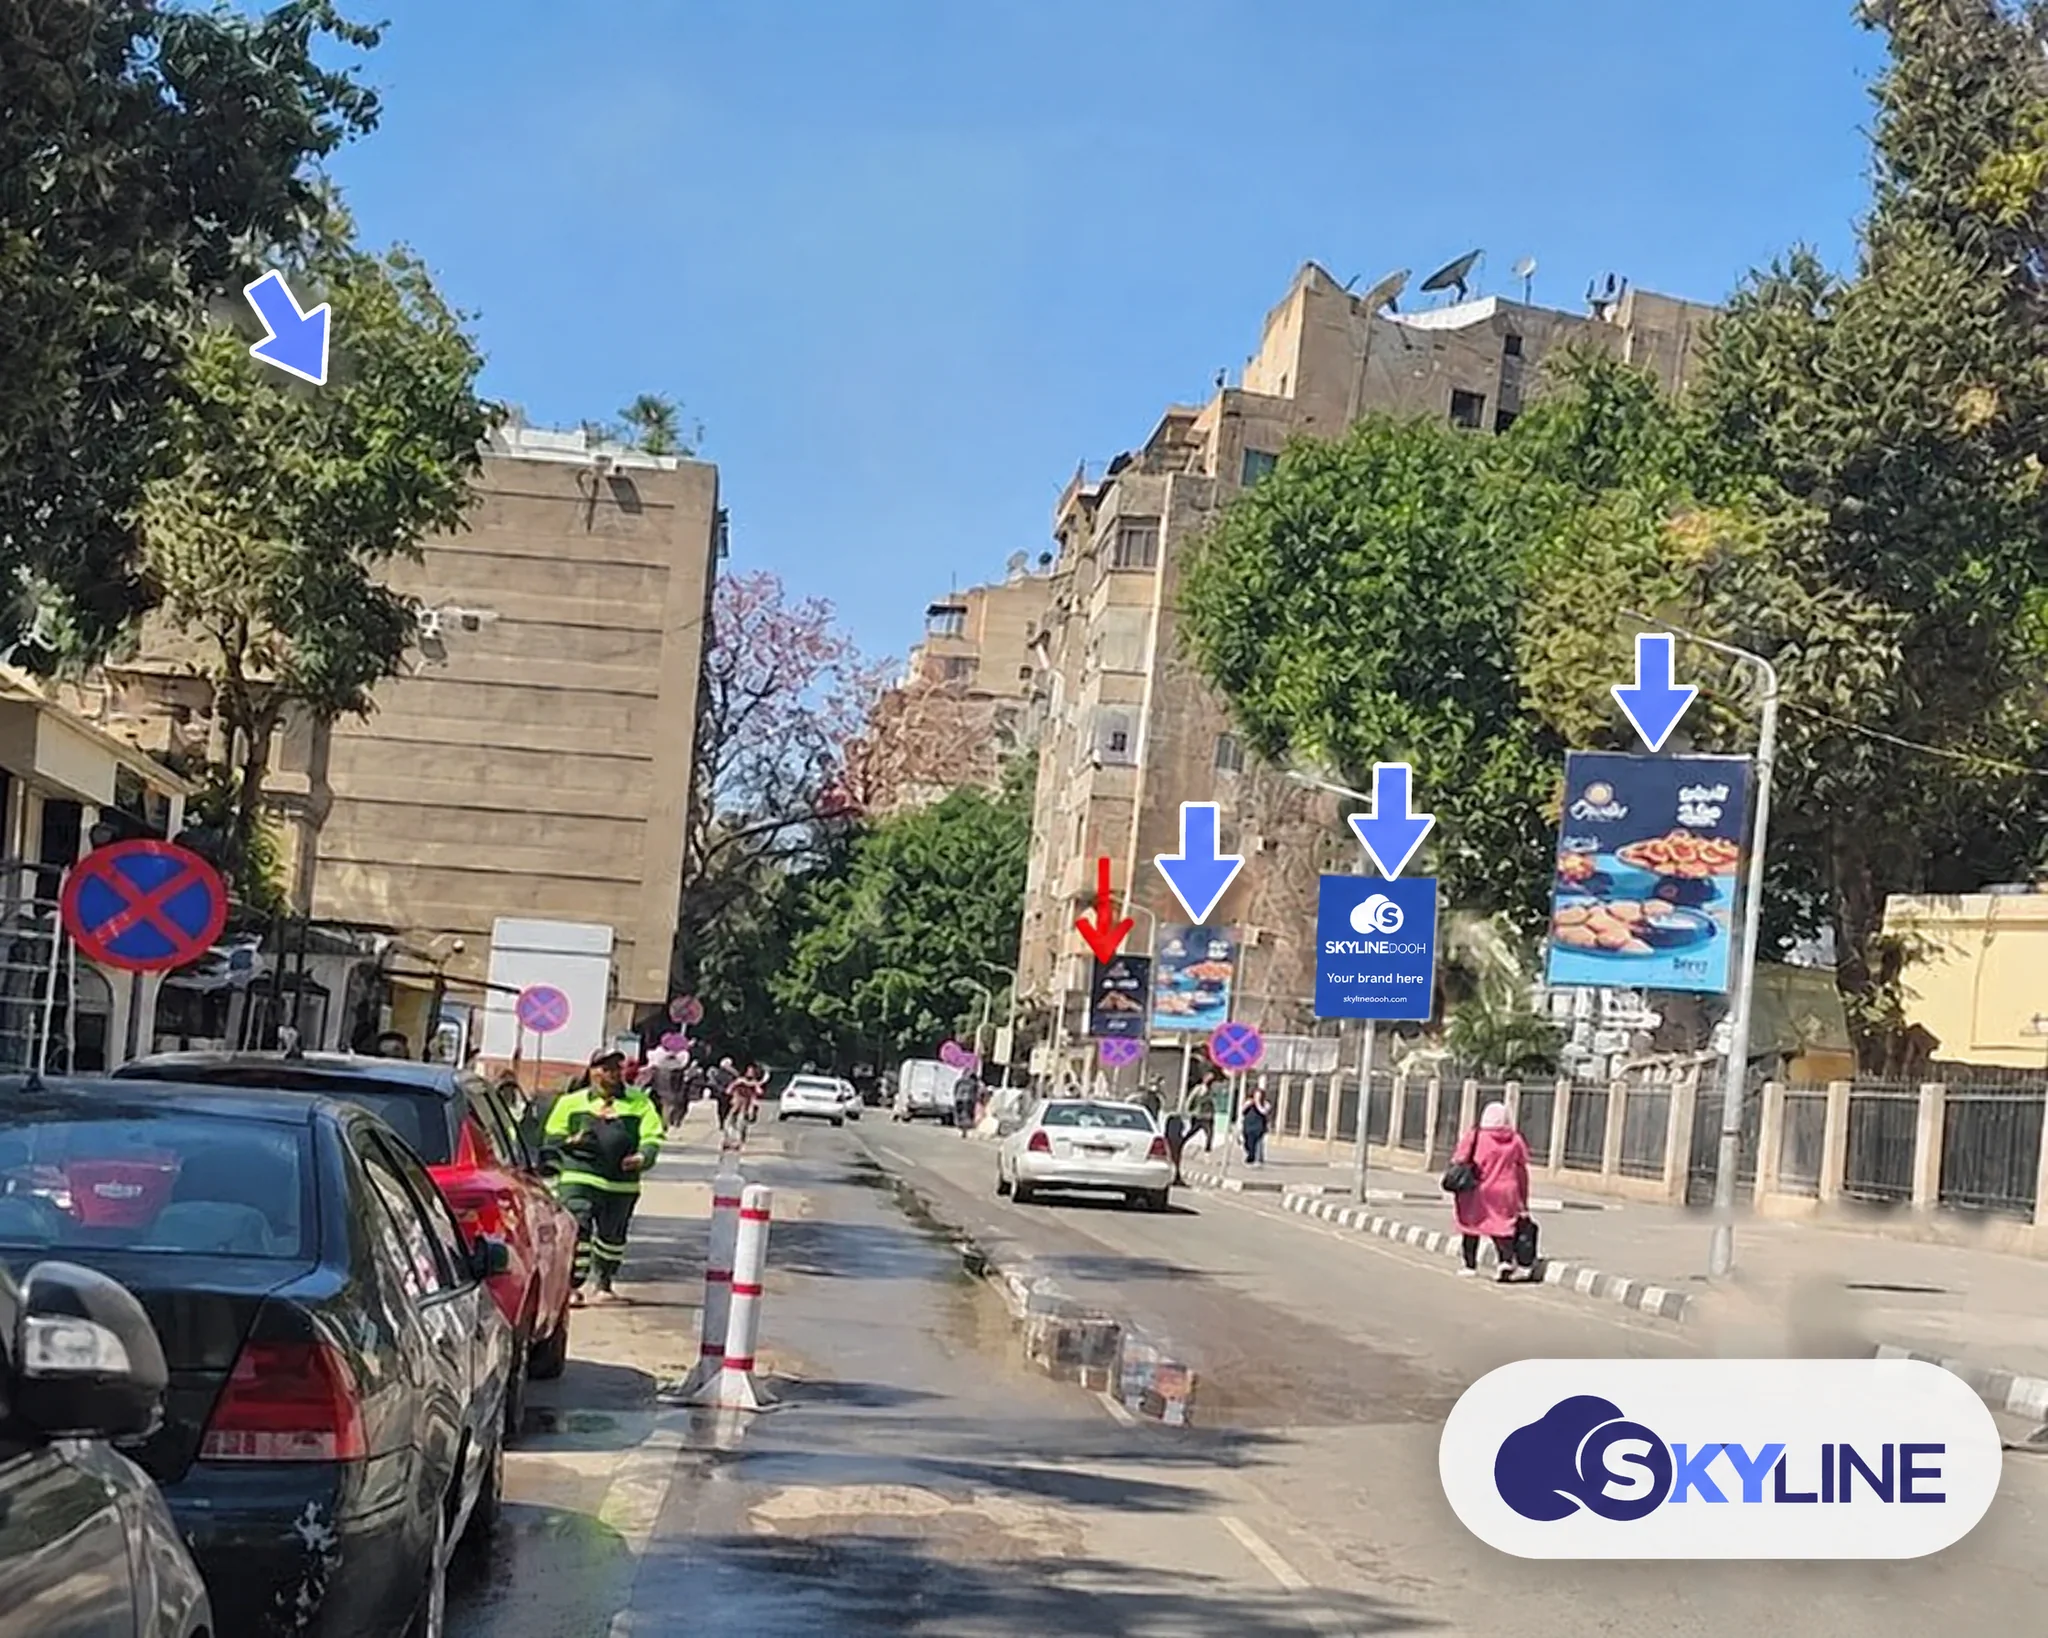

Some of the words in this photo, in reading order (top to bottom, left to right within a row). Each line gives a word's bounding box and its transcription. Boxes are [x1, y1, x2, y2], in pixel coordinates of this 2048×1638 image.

[1325, 940, 1426, 954] SKYLINEDOOH
[1326, 972, 1355, 983] Your
[1357, 972, 1393, 984] brand
[1396, 973, 1424, 984] here
